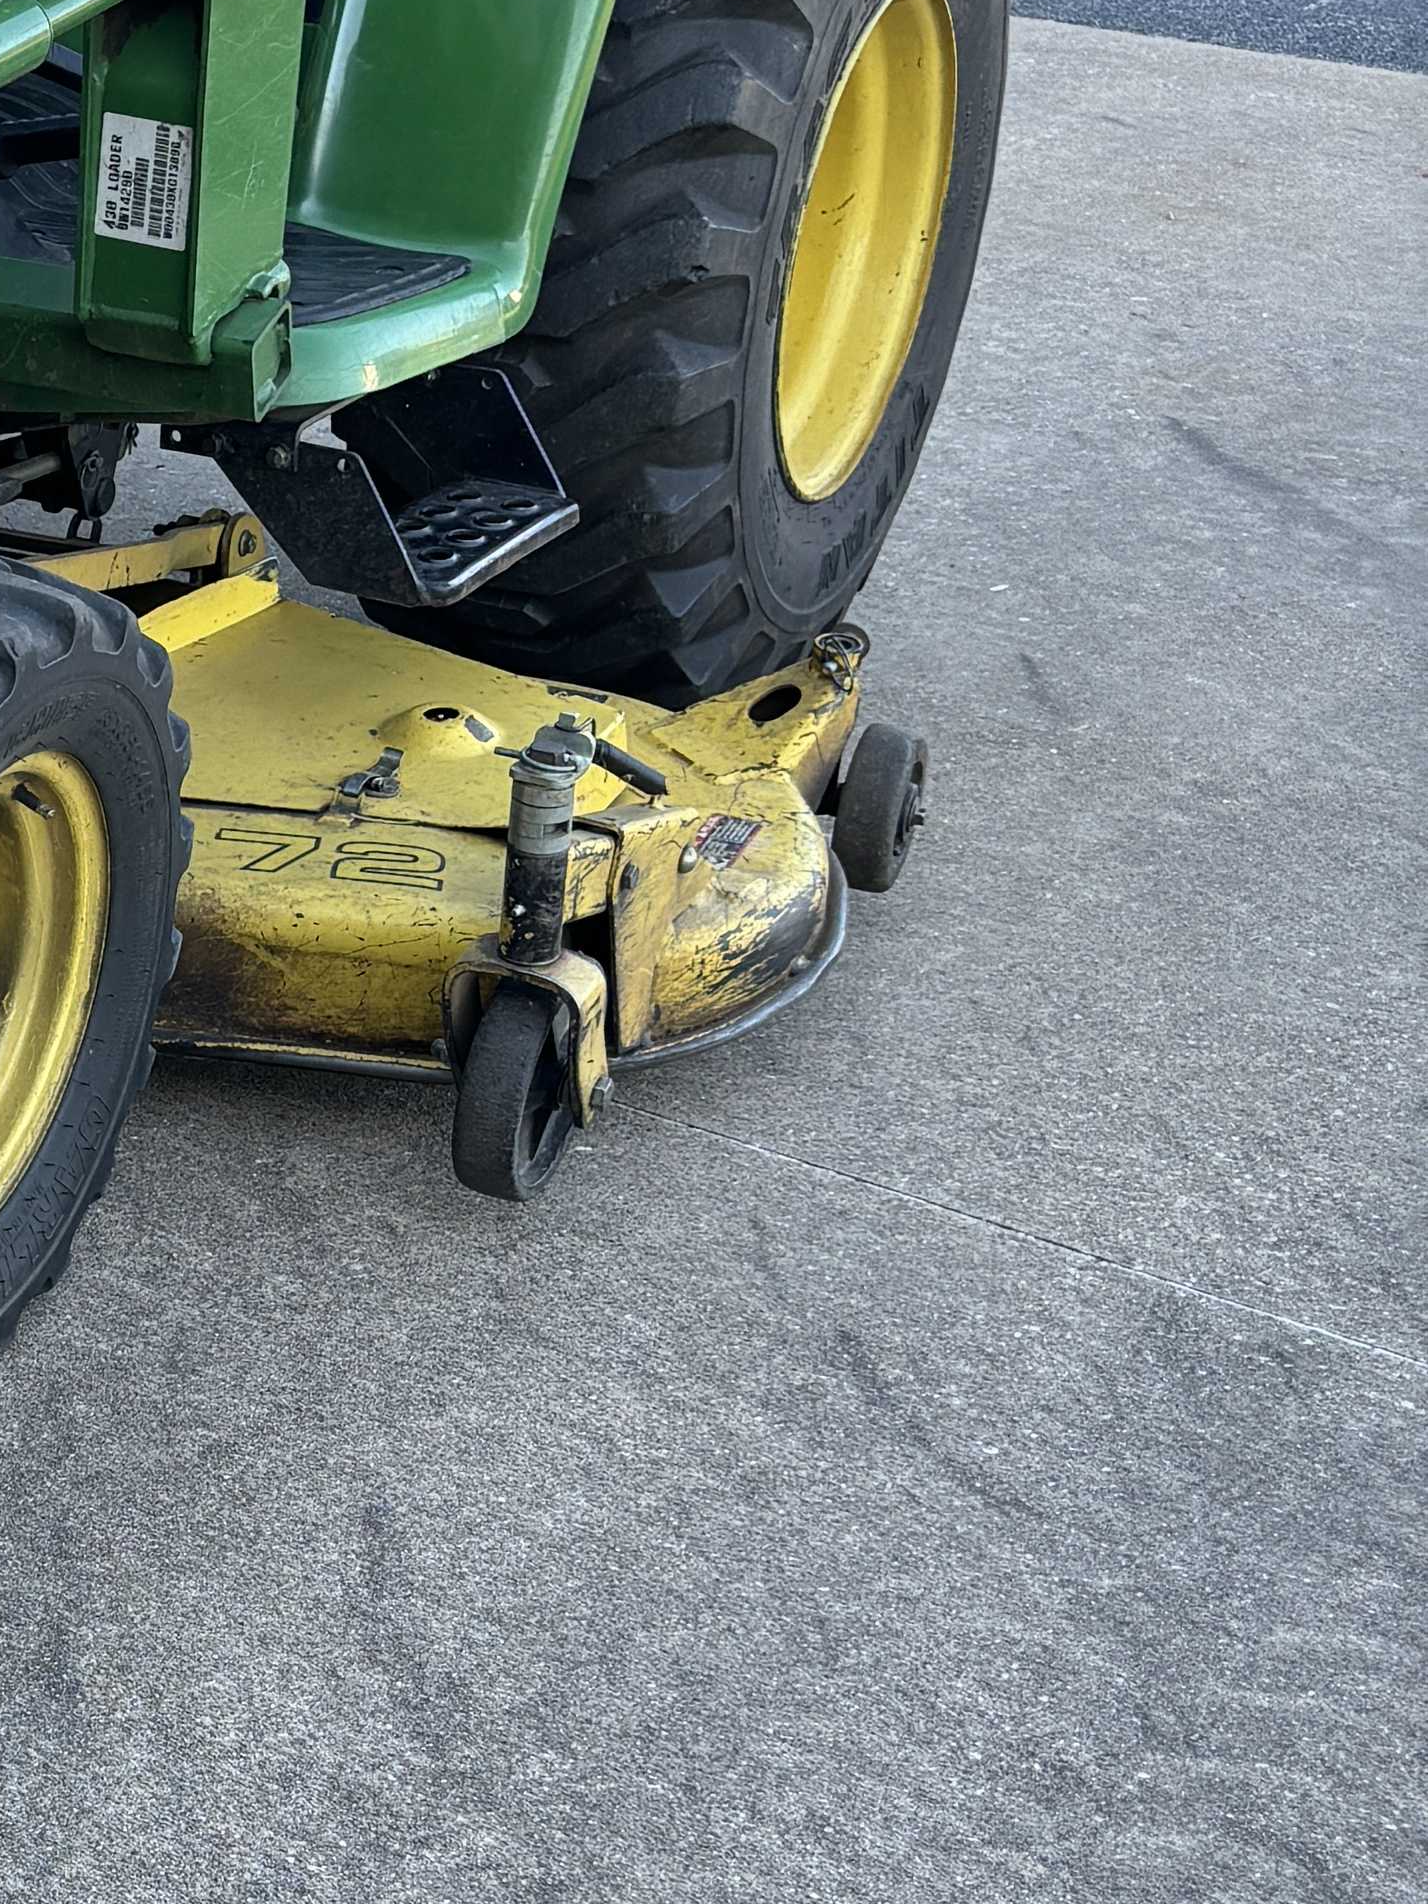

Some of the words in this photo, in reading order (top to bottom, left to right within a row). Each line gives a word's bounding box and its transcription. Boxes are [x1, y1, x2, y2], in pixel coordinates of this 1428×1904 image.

[108, 134, 124, 192] LOADER
[816, 383, 930, 597] TITAN
[214, 827, 447, 892] 72
